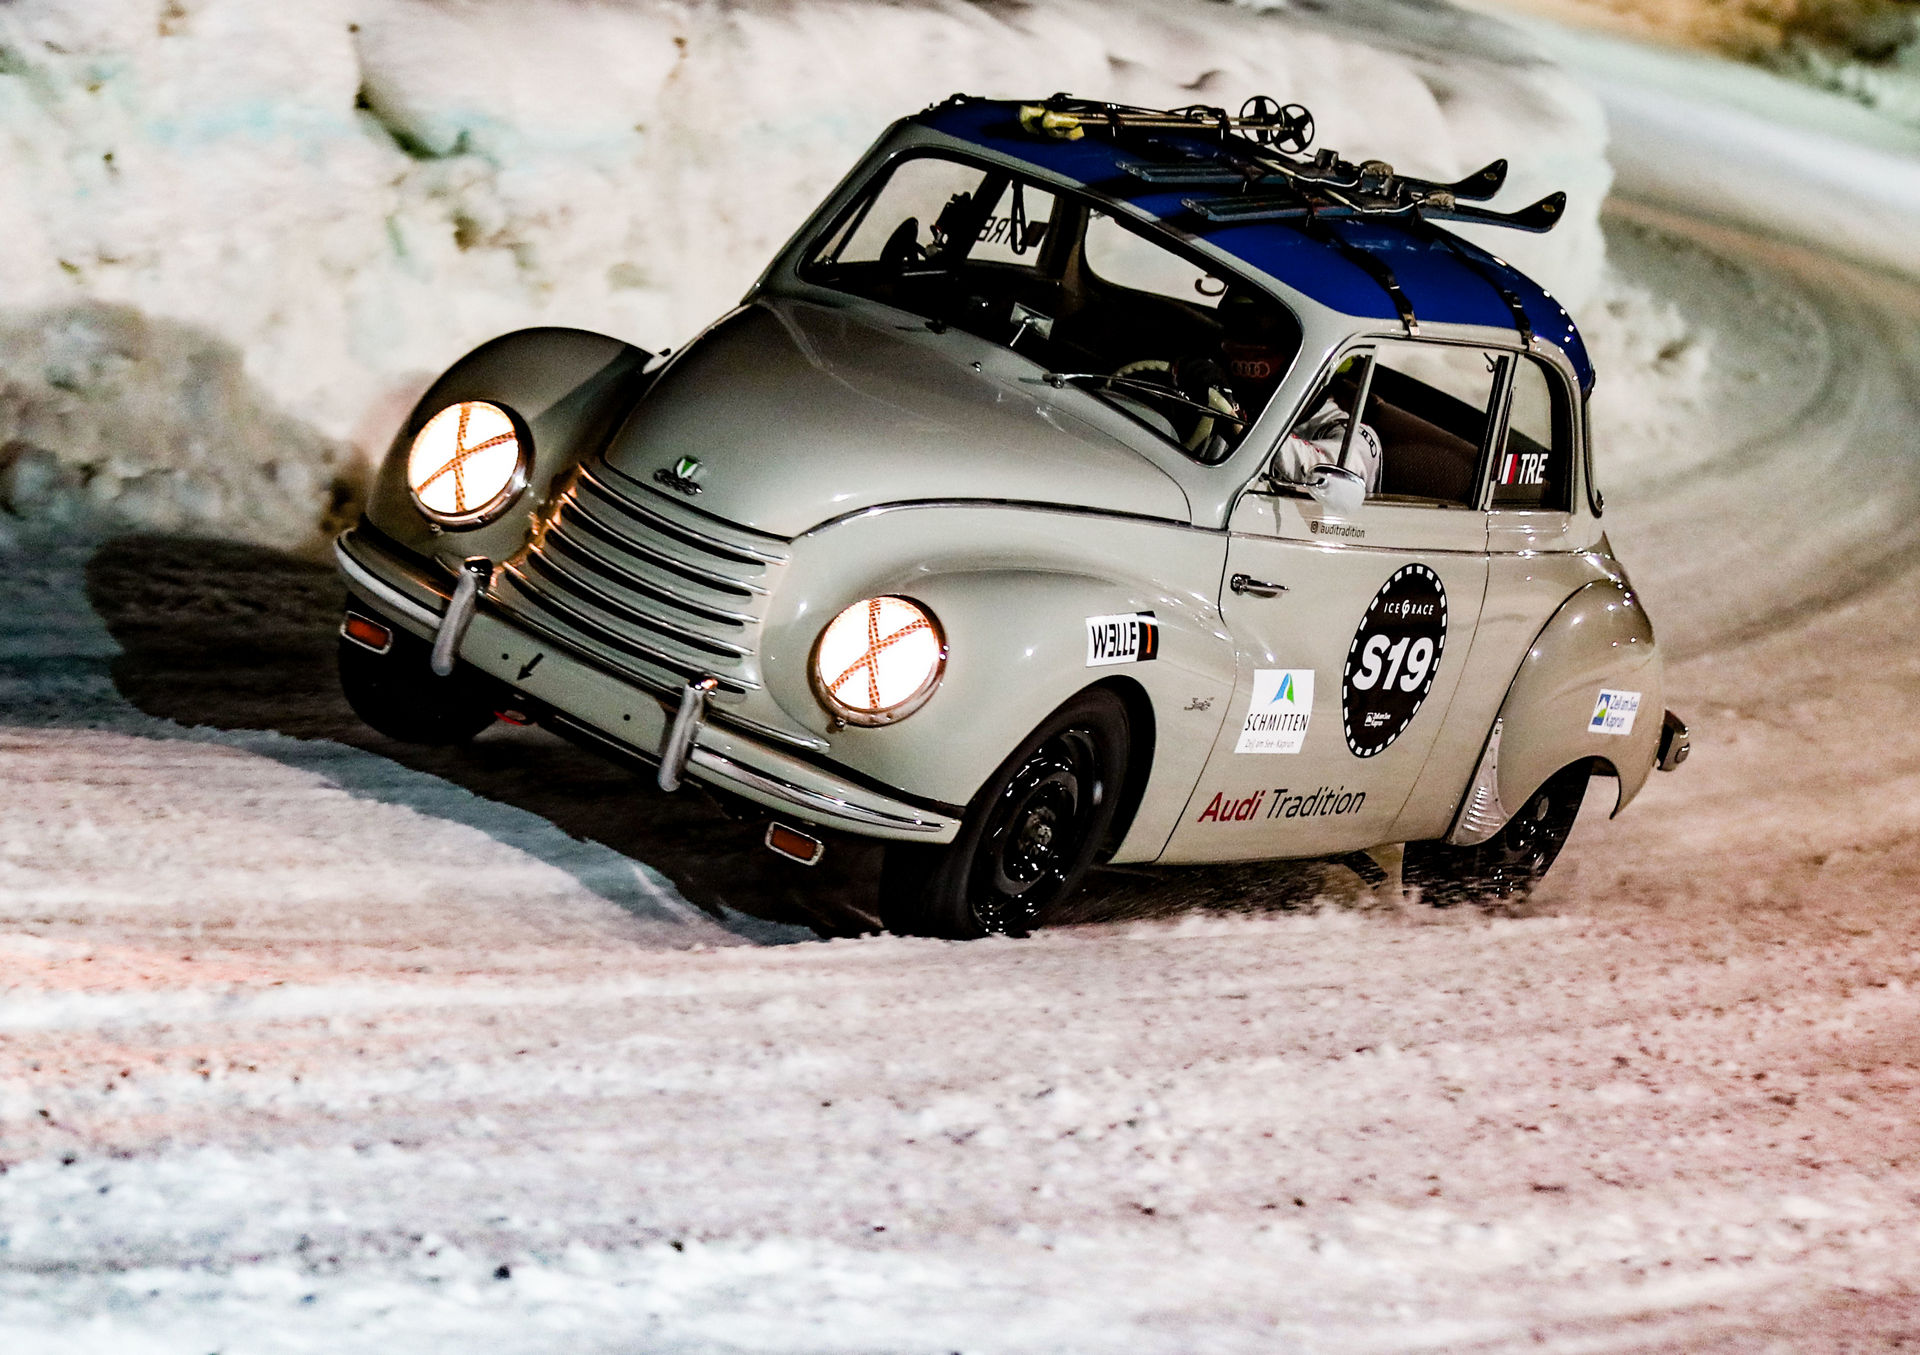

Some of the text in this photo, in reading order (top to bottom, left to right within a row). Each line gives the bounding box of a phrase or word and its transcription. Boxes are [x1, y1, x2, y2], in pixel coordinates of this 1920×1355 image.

[1518, 453, 1549, 485] TRE
[1320, 524, 1366, 538] auditradition
[1384, 602, 1434, 616] ICE RACE
[1352, 634, 1434, 692] S19
[1244, 713, 1309, 731] SCHMITTEN
[1197, 785, 1367, 822] Audi Tradition
